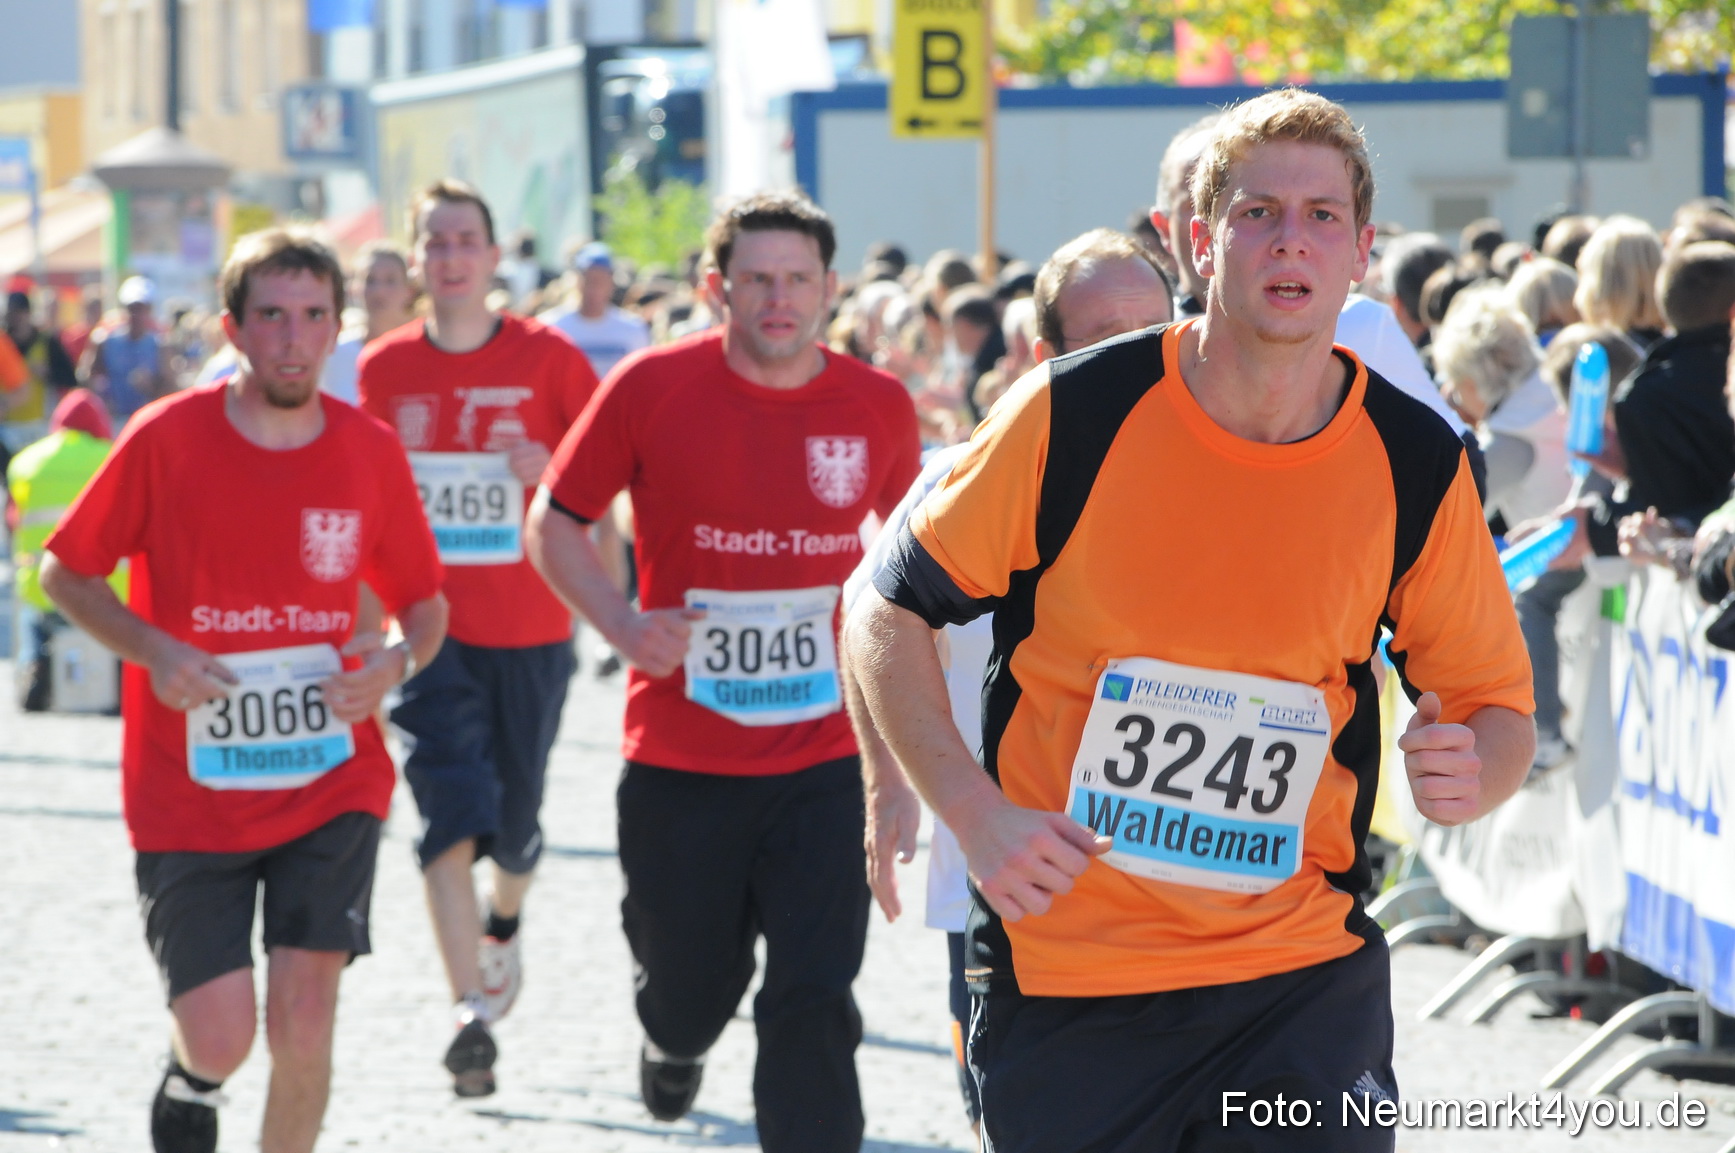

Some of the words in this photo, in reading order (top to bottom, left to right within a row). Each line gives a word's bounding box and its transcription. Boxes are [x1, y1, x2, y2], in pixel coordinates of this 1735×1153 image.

[921, 30, 965, 99] B
[694, 524, 858, 556] Stadt-Team
[705, 621, 816, 674] 3046
[208, 684, 327, 739] 3066
[715, 679, 811, 706] Günther
[1131, 697, 1234, 722] AKTIENGESELLSCHAFT
[1135, 678, 1237, 710] PFLEIDERER
[220, 745, 325, 771] Thomas
[1103, 714, 1297, 815] 3243
[1087, 792, 1286, 867] Waldemar
